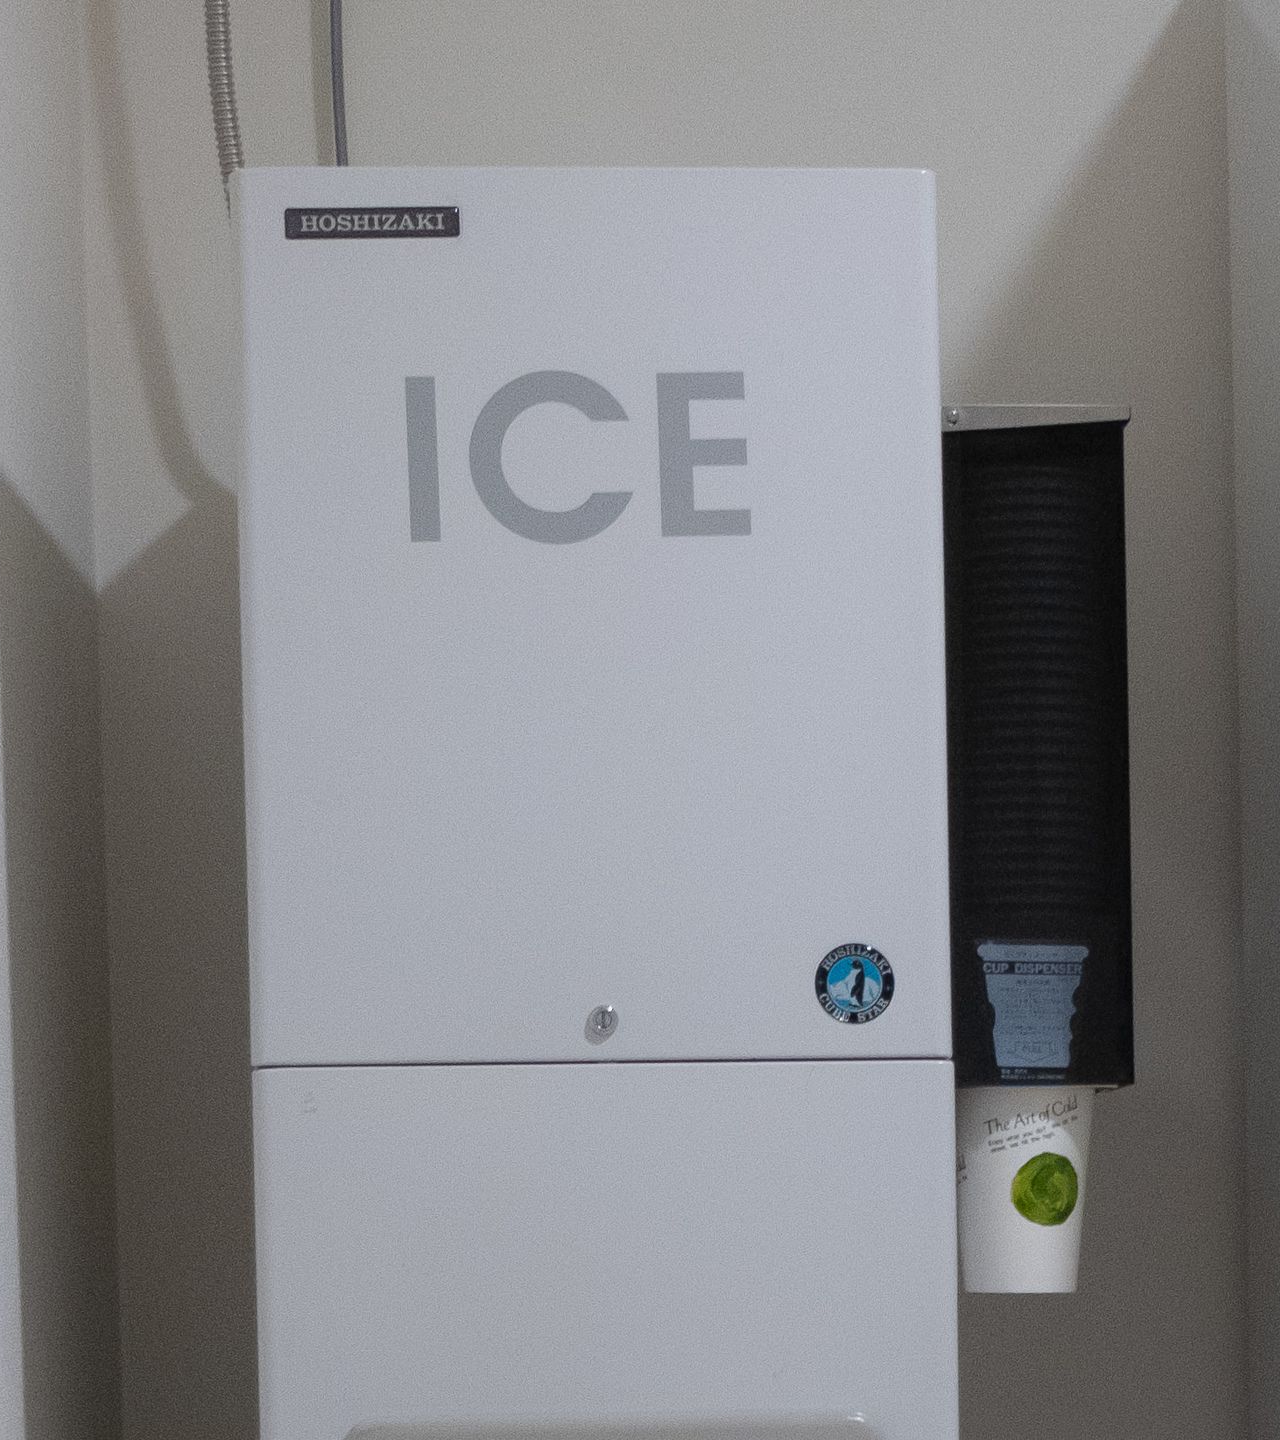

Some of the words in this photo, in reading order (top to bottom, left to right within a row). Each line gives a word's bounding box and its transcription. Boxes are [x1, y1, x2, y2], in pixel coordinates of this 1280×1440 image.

[300, 212, 445, 232] HOSHIZAKI
[404, 370, 752, 544] ICE
[982, 962, 1009, 975] CUP
[1014, 962, 1083, 976] DISPENSER
[983, 1116, 1011, 1135] The
[1013, 1112, 1037, 1129] Art
[1039, 1103, 1051, 1123] of
[1052, 1094, 1079, 1116] Cold
